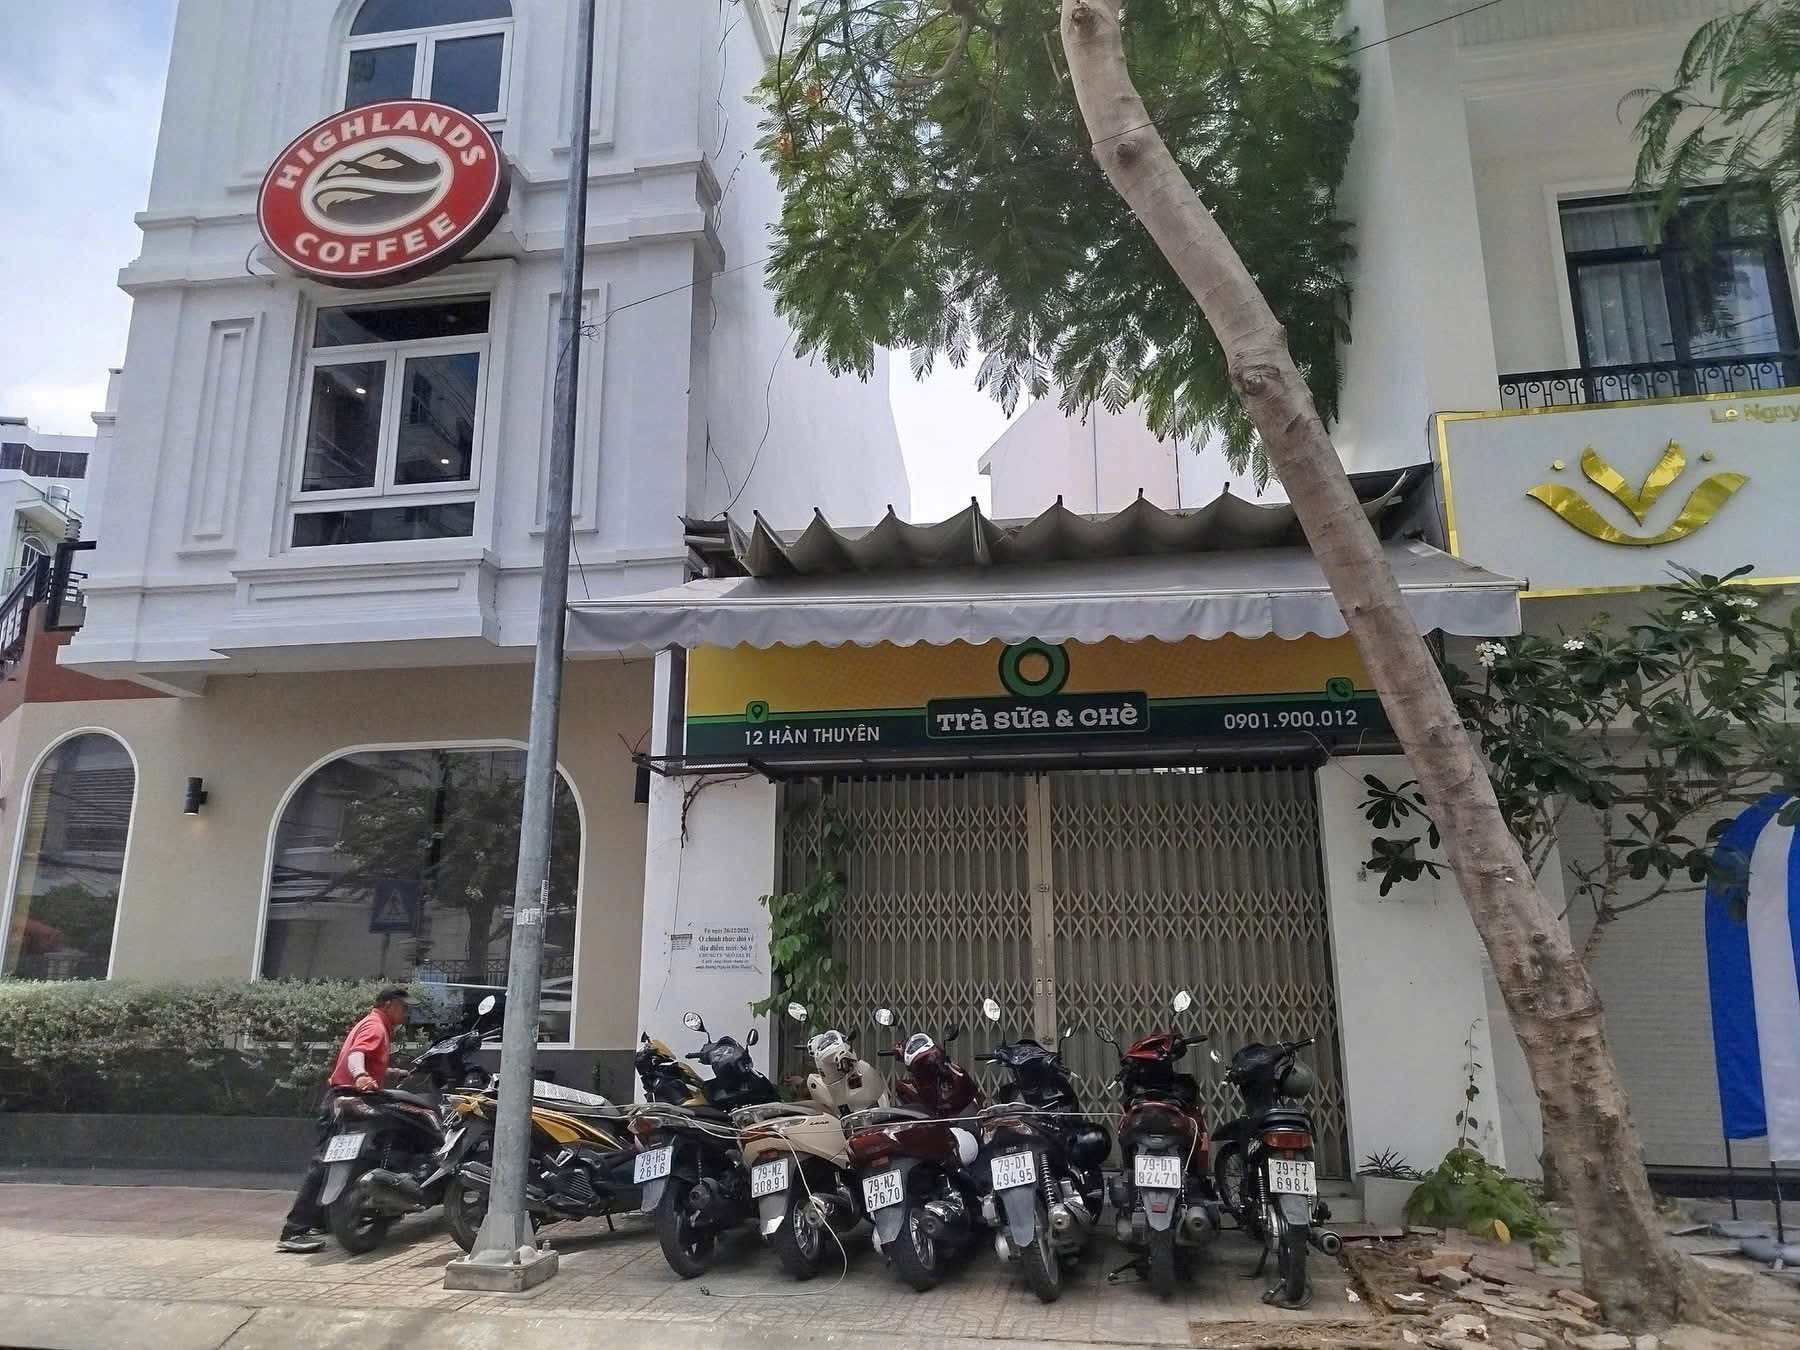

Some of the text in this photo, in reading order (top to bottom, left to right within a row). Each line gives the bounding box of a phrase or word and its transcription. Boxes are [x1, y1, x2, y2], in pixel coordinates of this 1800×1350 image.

[275, 110, 486, 190] HIGHLANDS
[295, 212, 456, 264] COFFEE
[1055, 709, 1074, 727] &
[1224, 709, 1358, 730] 0901.900.012
[745, 724, 880, 746] 12 HÀN THUYÊN
[641, 1152, 666, 1167] 79-H5
[999, 1156, 1026, 1172] 79-D1
[639, 1162, 665, 1180] 2616
[997, 1168, 1033, 1187] 494.95
[1139, 1172, 1178, 1186] 824.70
[754, 1177, 785, 1194] 308.91
[868, 1174, 895, 1193] 79-N2
[1277, 1177, 1310, 1193] 6984
[867, 1187, 900, 1209] 676.70
